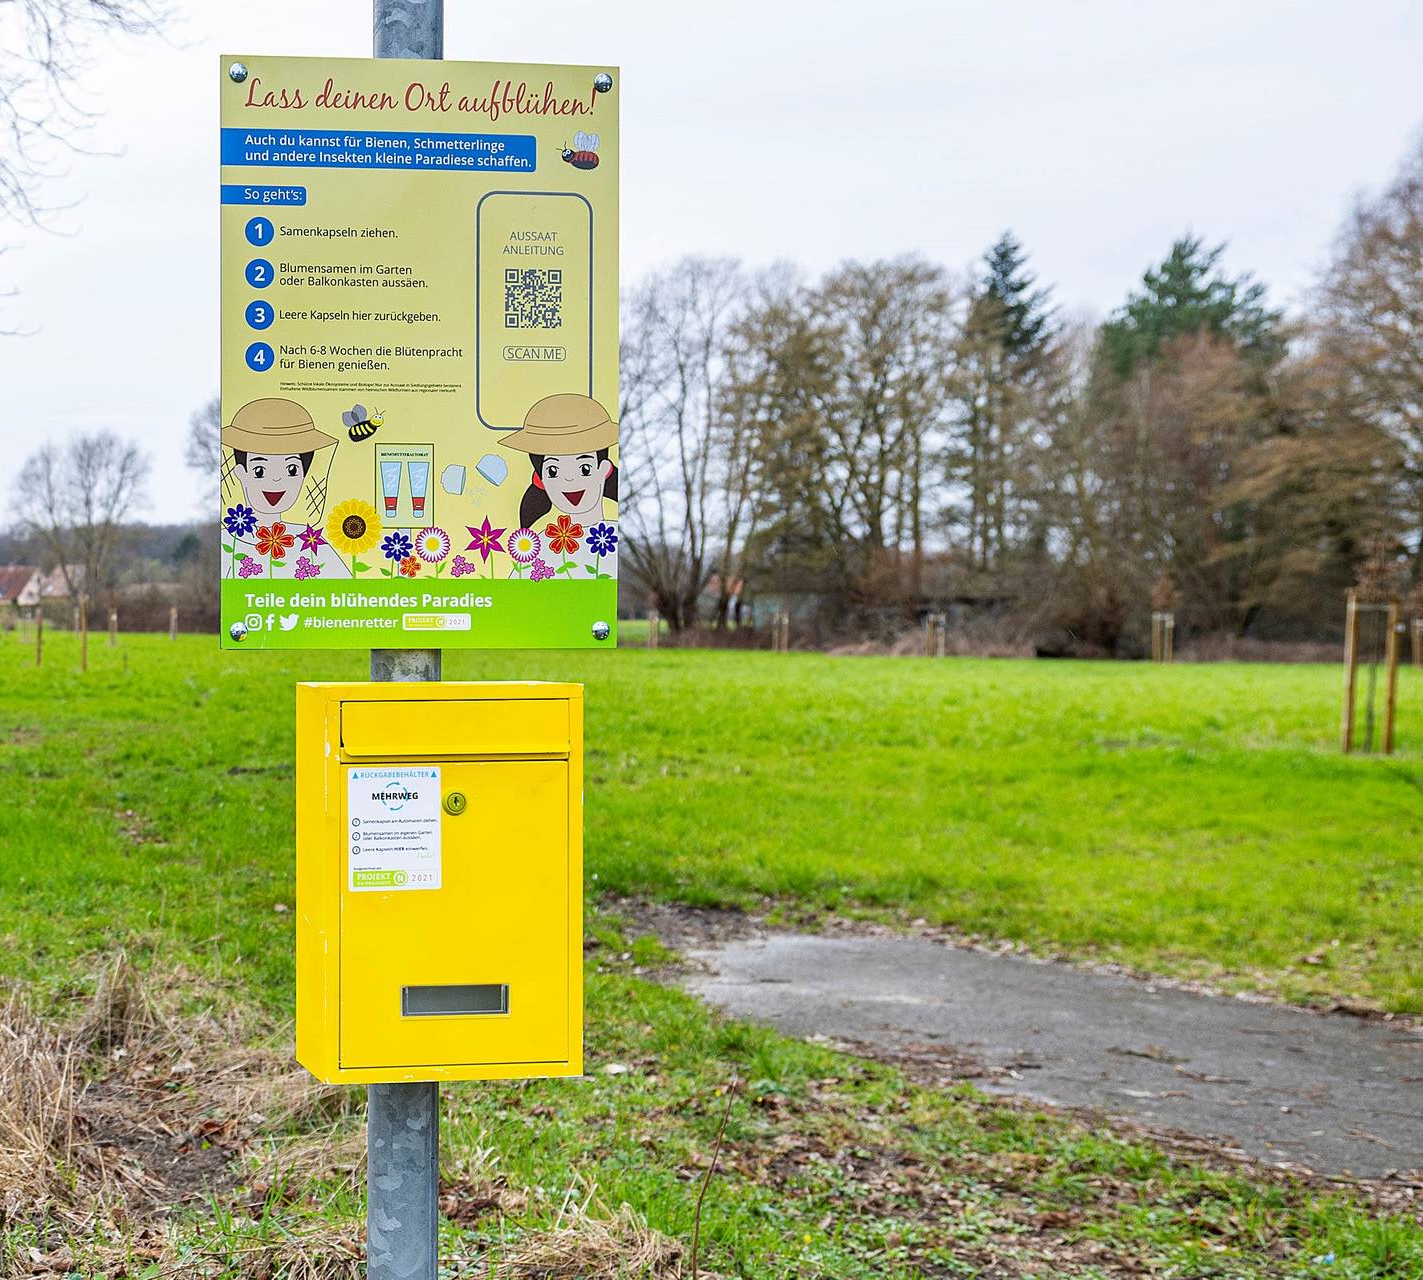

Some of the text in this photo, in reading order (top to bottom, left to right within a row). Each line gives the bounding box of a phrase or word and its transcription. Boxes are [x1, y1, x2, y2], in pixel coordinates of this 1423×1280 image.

[245, 78, 598, 122] Lass deinen Ort aufblühen!
[245, 134, 505, 152] Auch du kannst für Bienen, Schmetterlinge
[245, 150, 532, 168] und andere Insekten kleine Paradiese schaffen.
[244, 188, 302, 203] So geht's:
[254, 224, 263, 239] 1
[280, 226, 398, 239] Samenkapseln ziehen.
[510, 232, 557, 242] AUSSAAT
[503, 246, 564, 256] ANLEITUNG
[254, 266, 265, 282] 2
[280, 263, 412, 275] Blumensamen im Garten
[280, 276, 428, 288] oder Balkonkasten aussäen.
[254, 308, 266, 322] 3
[280, 310, 441, 324] Leere Kapseln hier zurückgeben.
[254, 350, 266, 364] 4
[280, 346, 462, 359] Nach 6-8 Wochen die Blütenpracht
[508, 348, 562, 360] SCAN ME
[280, 359, 390, 372] für Bienen genießen.
[245, 594, 492, 608] Teile dein blühendes Paradies
[304, 616, 398, 629] #bienenretter
[372, 792, 418, 800] MEHRWEG
